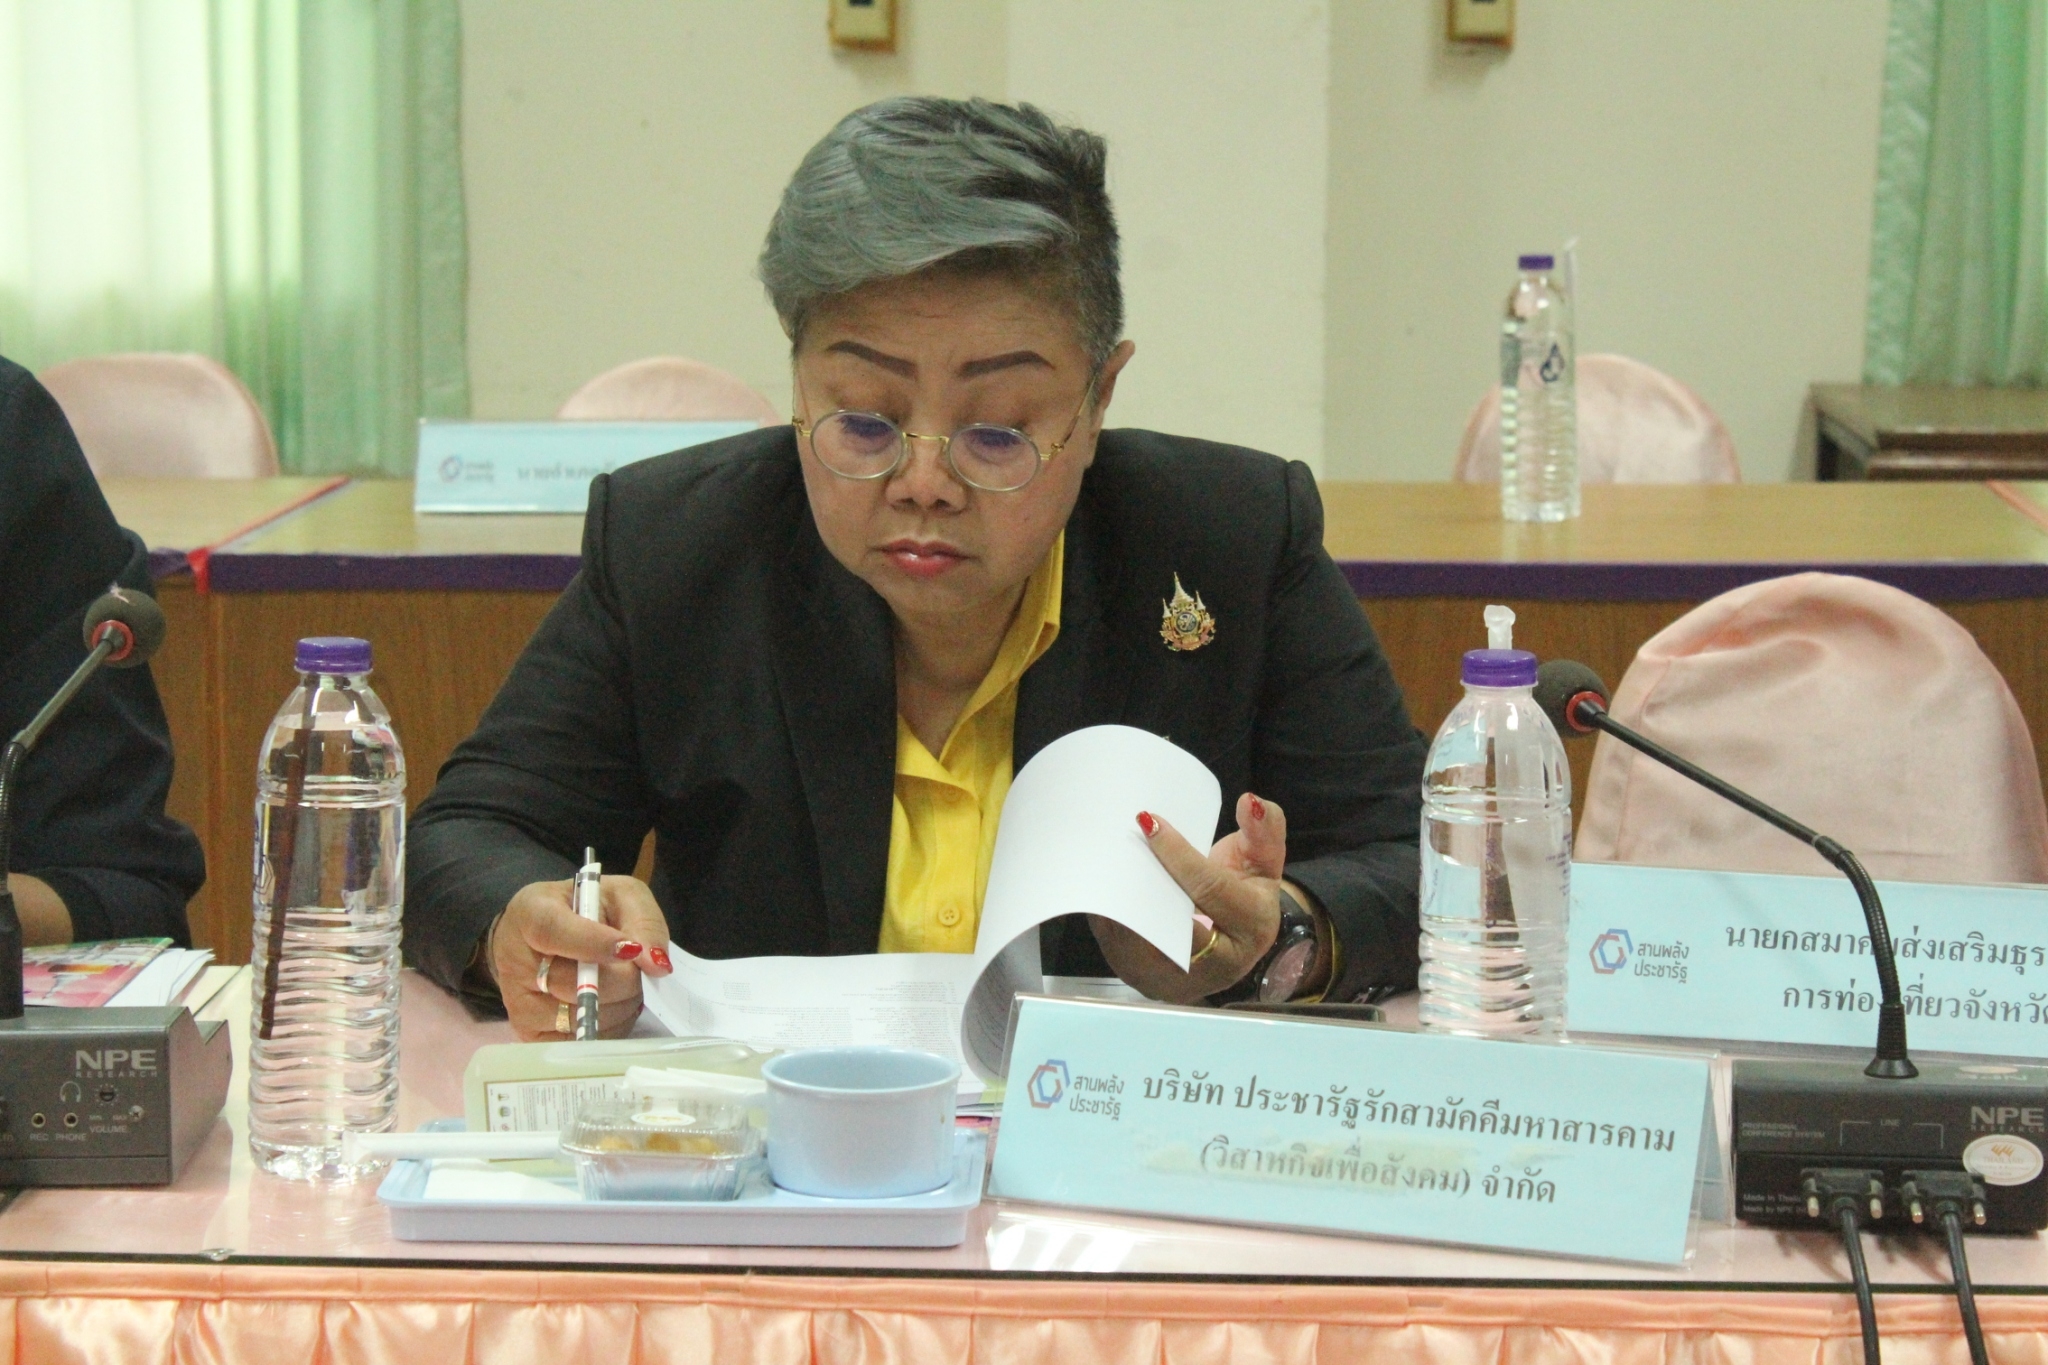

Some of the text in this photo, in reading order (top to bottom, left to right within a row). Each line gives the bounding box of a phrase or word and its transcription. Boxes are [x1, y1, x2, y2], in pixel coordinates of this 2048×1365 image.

[1637, 940, 1690, 960] สานพลัง
[1726, 924, 2047, 976] นายกสมาคส่งเสริมธุร
[1634, 958, 1688, 984] ประชารัฐ
[1782, 972, 2048, 1025] การท่อที่ยวจังหวั
[76, 1050, 157, 1070] NPE
[76, 1070, 158, 1078] RESEARCH
[1073, 1074, 1125, 1094] สานพลัง
[1069, 1093, 1122, 1121] ประชารัฐ
[1143, 1068, 1676, 1152] บริษัท ประชารัฐรักสามัคคีมหาสารคาม
[1970, 1105, 2045, 1127] NPE
[29, 1133, 88, 1141] REC PHONE
[89, 1125, 127, 1134] VOLUME
[1482, 1165, 1556, 1204] จำกัด
